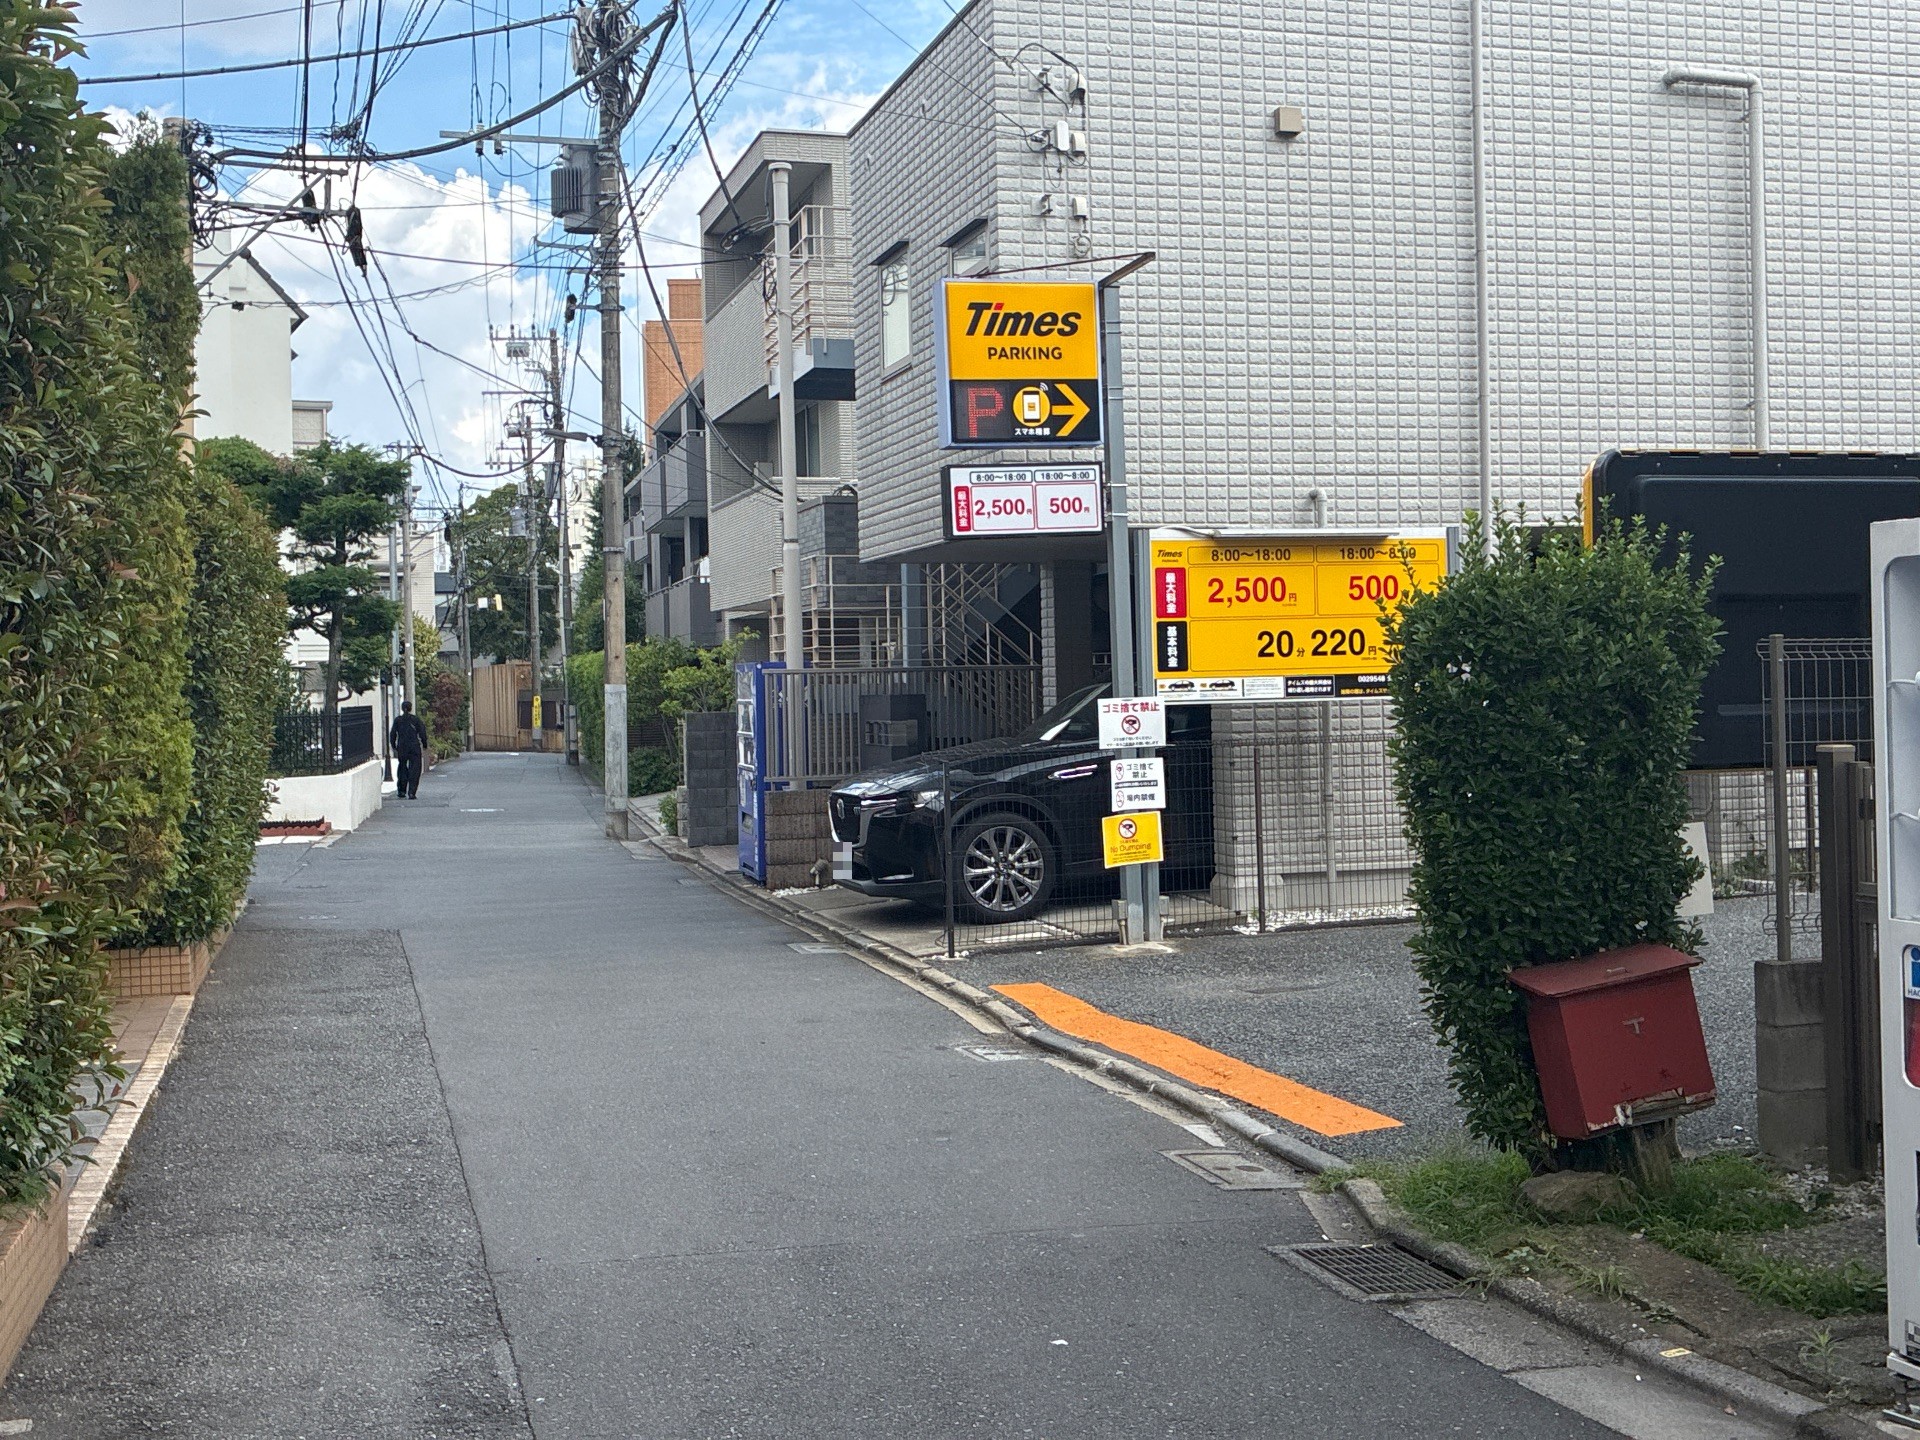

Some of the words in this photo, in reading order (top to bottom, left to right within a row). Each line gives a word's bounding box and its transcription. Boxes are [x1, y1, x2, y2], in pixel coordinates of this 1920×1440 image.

[965, 302, 1082, 337] Times
[987, 346, 1063, 360] PARKING
[967, 387, 1004, 439] P
[957, 490, 969, 527] 最大料金
[1156, 549, 1183, 558] Times
[1165, 572, 1177, 614] 最大料金
[1166, 625, 1179, 668] 基本料金
[1102, 701, 1160, 713] ゴミ捨て禁止
[1126, 763, 1154, 771] ゴミ捨て
[1132, 771, 1148, 779] 禁止
[1126, 793, 1156, 802] 場内禁煙
[1110, 845, 1118, 853] No
[1119, 842, 1152, 852] Dumping
